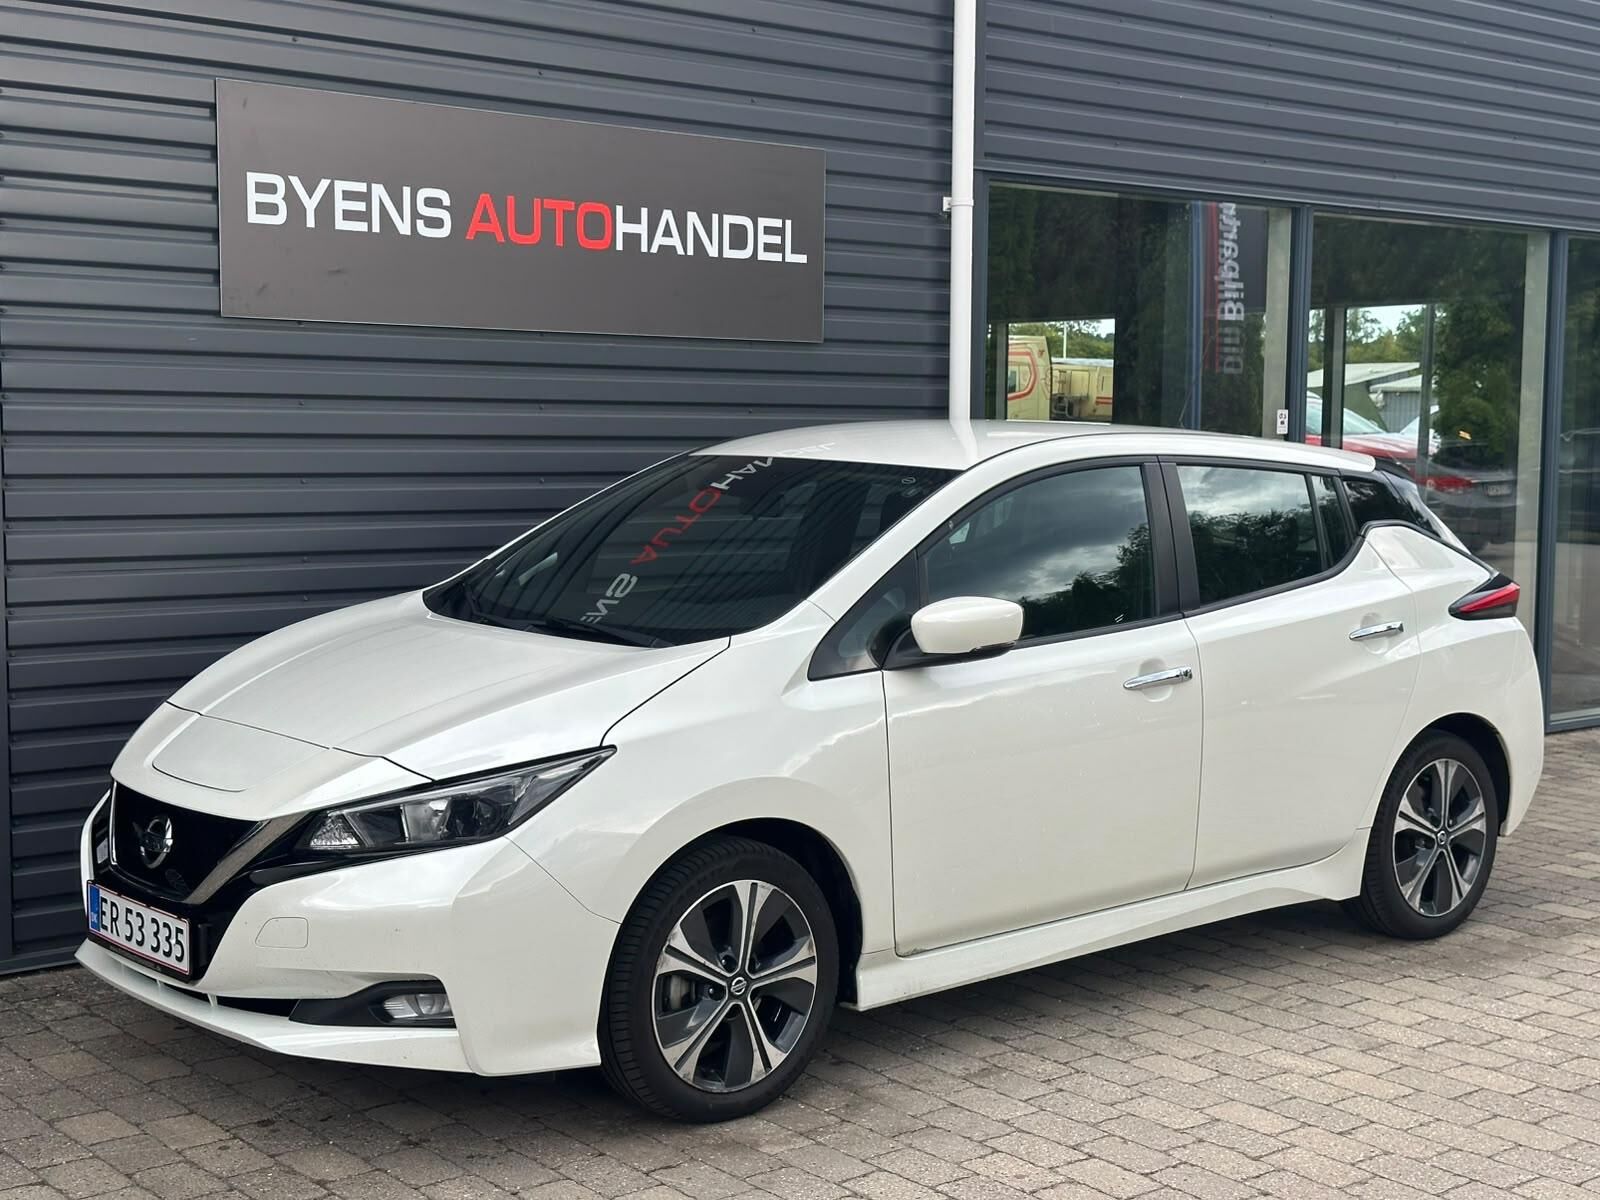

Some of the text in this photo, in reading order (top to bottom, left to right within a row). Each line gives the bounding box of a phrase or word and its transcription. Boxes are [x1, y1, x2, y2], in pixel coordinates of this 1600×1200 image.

[247, 172, 807, 263] BYENS AUTOHANDEL
[100, 896, 185, 963] ER 53 335
